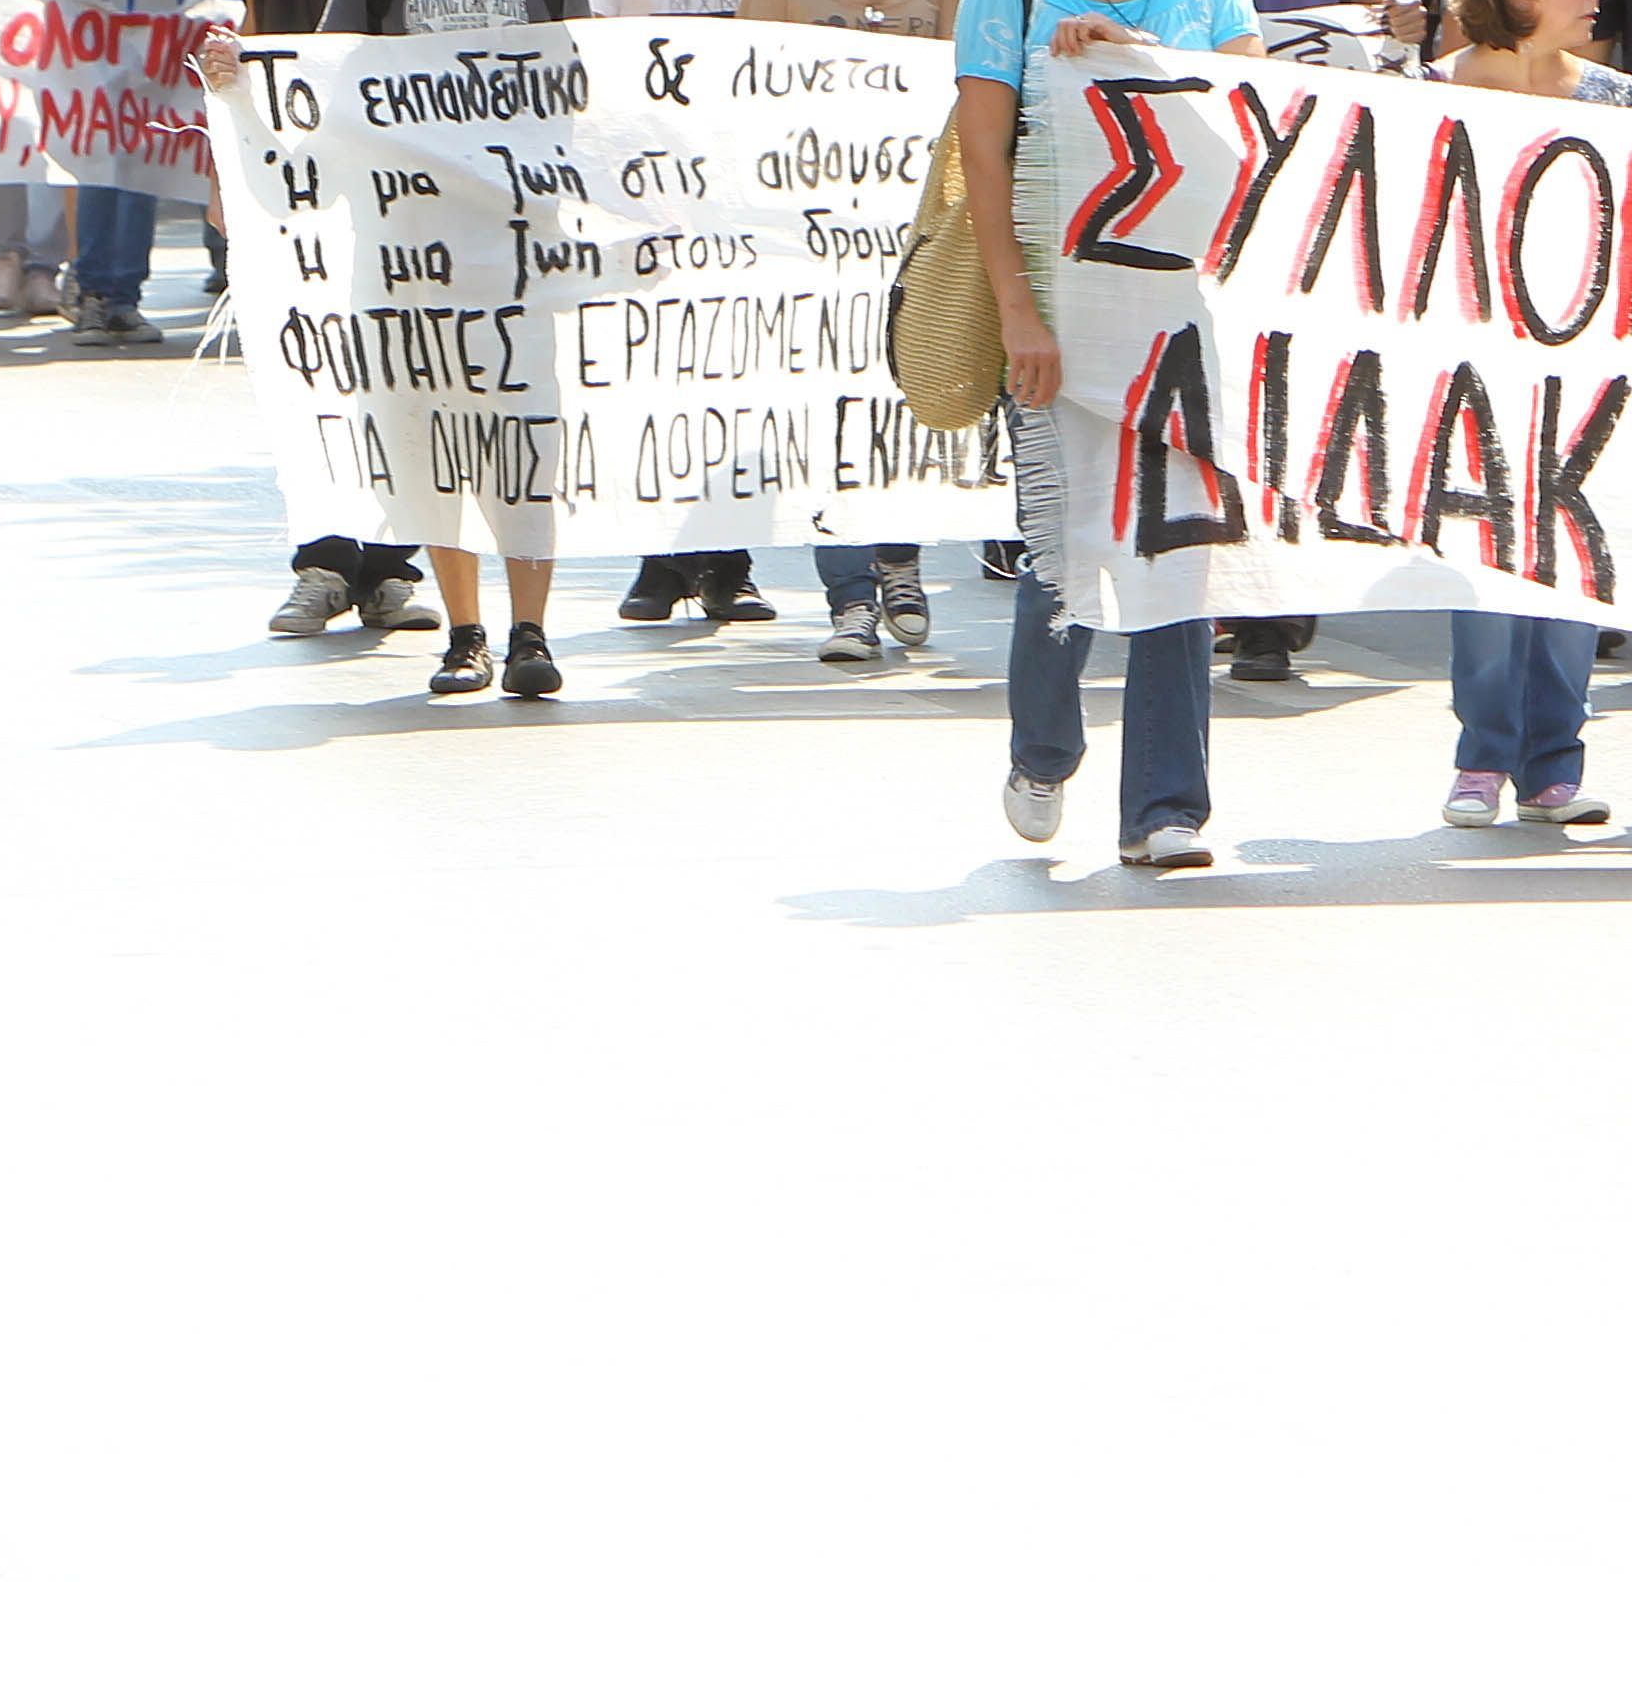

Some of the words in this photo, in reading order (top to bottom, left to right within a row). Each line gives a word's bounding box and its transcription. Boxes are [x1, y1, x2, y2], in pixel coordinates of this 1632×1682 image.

[240, 50, 319, 131] Το
[645, 37, 696, 106] δε
[732, 45, 910, 98] λύνεται
[39, 87, 212, 176] ΜΑΘΗΜ
[371, 169, 441, 218] μια
[485, 144, 589, 215] ζωή
[621, 150, 707, 199] στις
[379, 239, 453, 295] μια
[636, 232, 758, 275] στους
[279, 304, 531, 398] ΦΟΙΤΗΤΕΣ
[578, 288, 886, 388] ΕΡΓΑΖΟΜΕΝΟΙ
[316, 411, 396, 497] ΓΙΑ
[636, 402, 810, 505] ΔΩΡΕΑΝ
